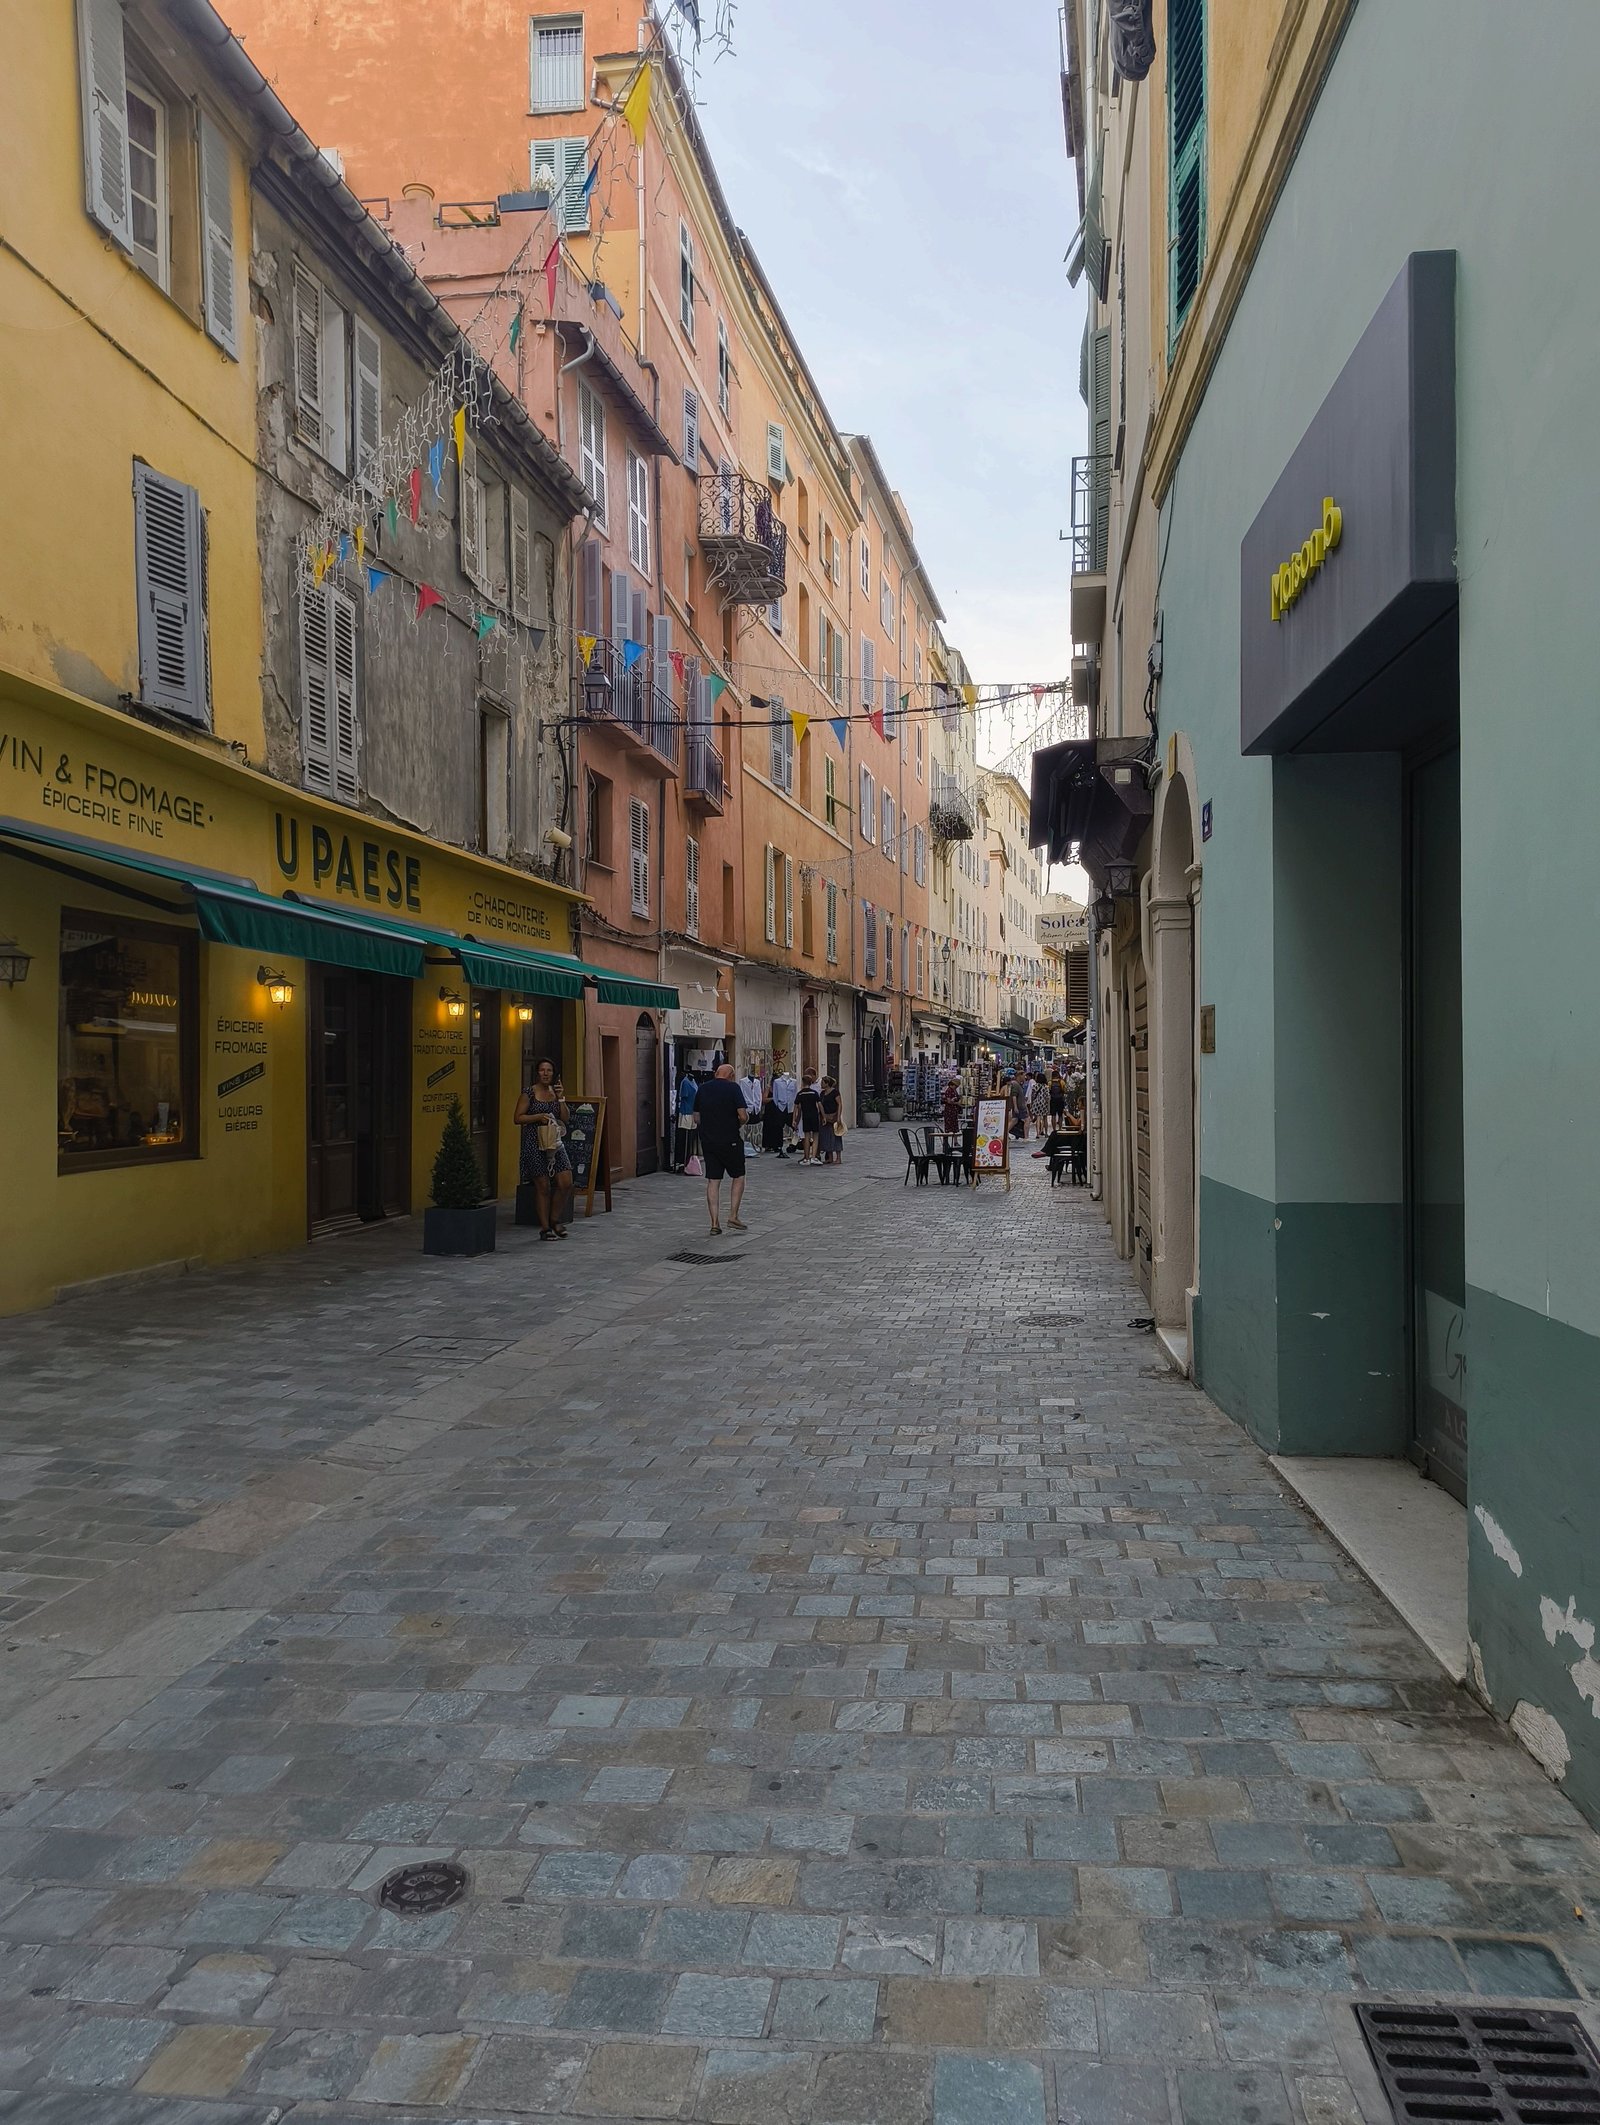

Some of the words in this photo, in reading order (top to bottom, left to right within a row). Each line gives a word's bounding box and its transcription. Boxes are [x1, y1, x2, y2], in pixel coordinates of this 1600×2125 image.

[55, 753, 72, 785] &
[42, 781, 121, 827] ÉPICERIE
[128, 812, 164, 839] FINE
[275, 812, 298, 880] U
[312, 824, 421, 911] PAESE
[473, 892, 545, 926] CHARCUTERIE
[467, 910, 482, 924] DE
[485, 914, 504, 930] NOS
[506, 920, 551, 941] MONTAGNES
[217, 1015, 264, 1034] ÉPICERIE
[214, 1041, 268, 1055] FROMAGE
[218, 1104, 264, 1118] LIQUEURS
